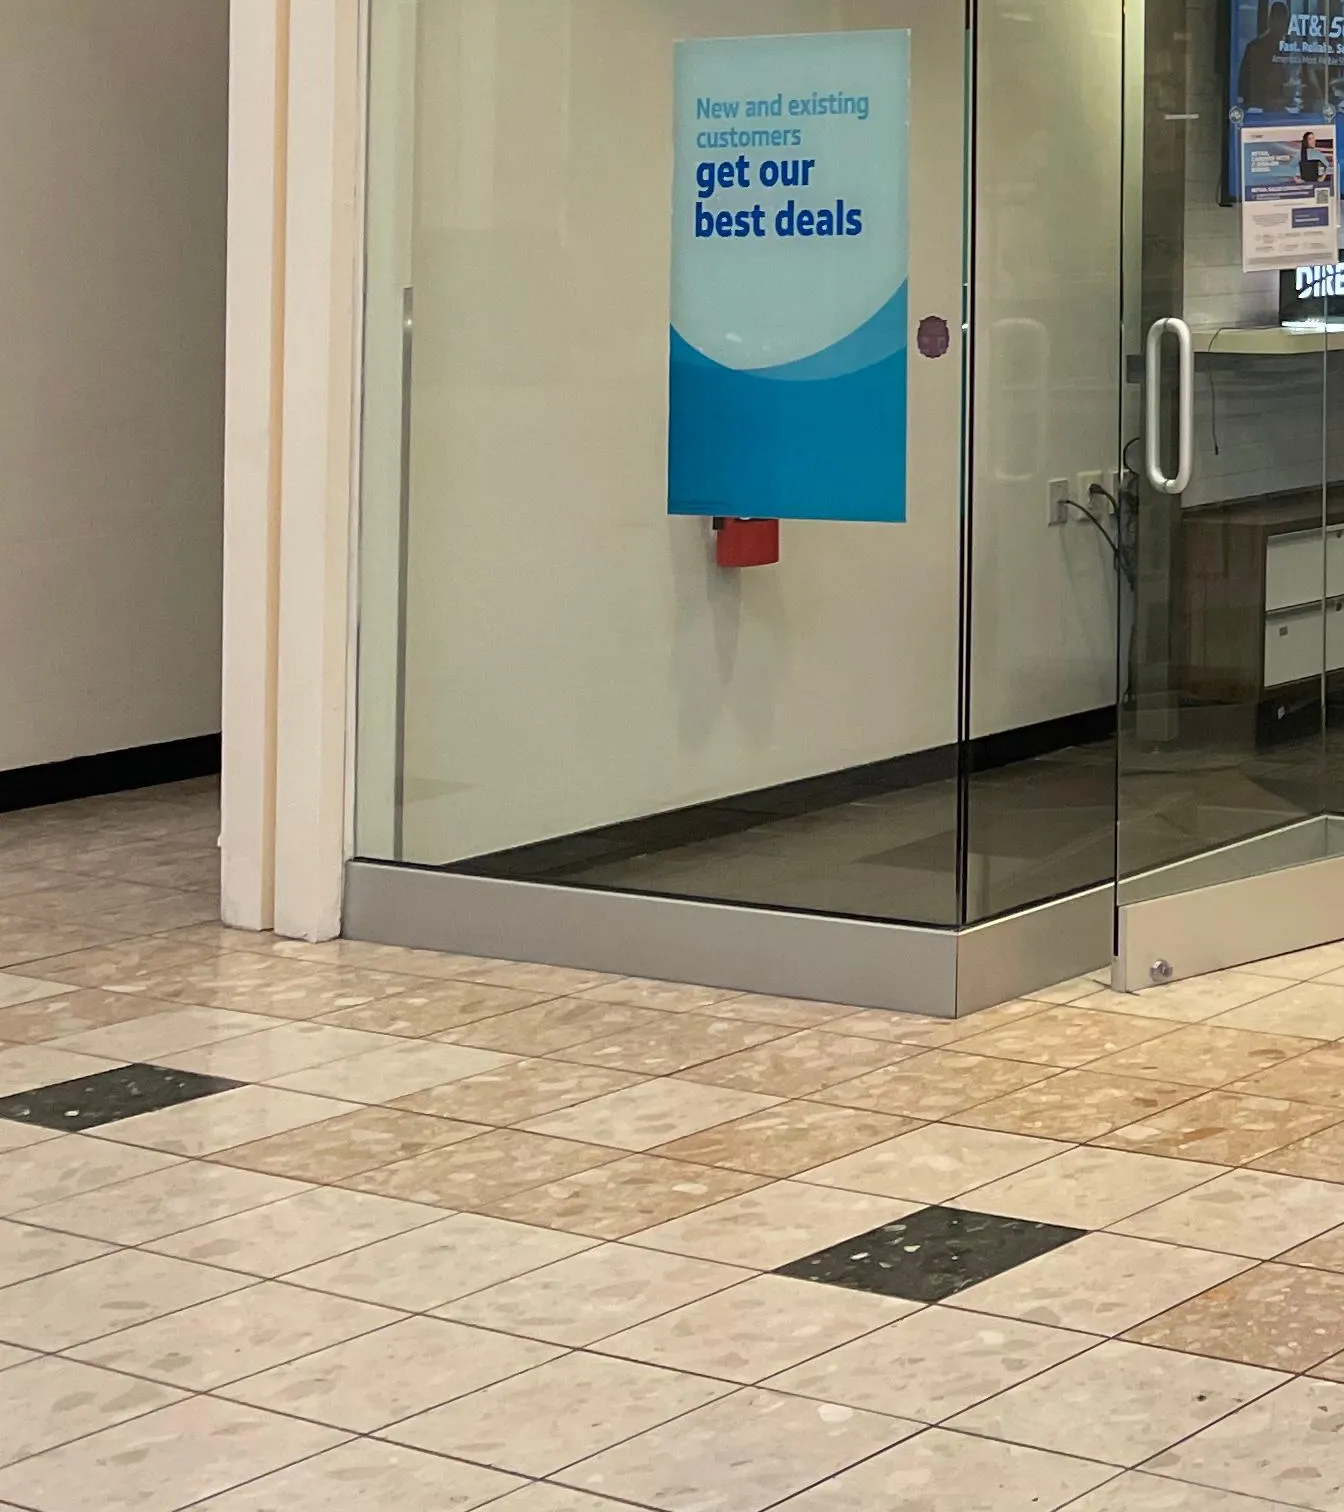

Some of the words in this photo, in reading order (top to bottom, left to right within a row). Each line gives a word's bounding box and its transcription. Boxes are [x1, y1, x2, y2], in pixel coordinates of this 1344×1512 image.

[696, 97, 740, 120] New
[745, 93, 783, 118] and
[788, 91, 870, 120] existing
[696, 127, 802, 149] customers
[696, 155, 751, 199] get
[759, 159, 816, 187] our
[695, 201, 766, 238] best
[775, 199, 863, 237] deals
